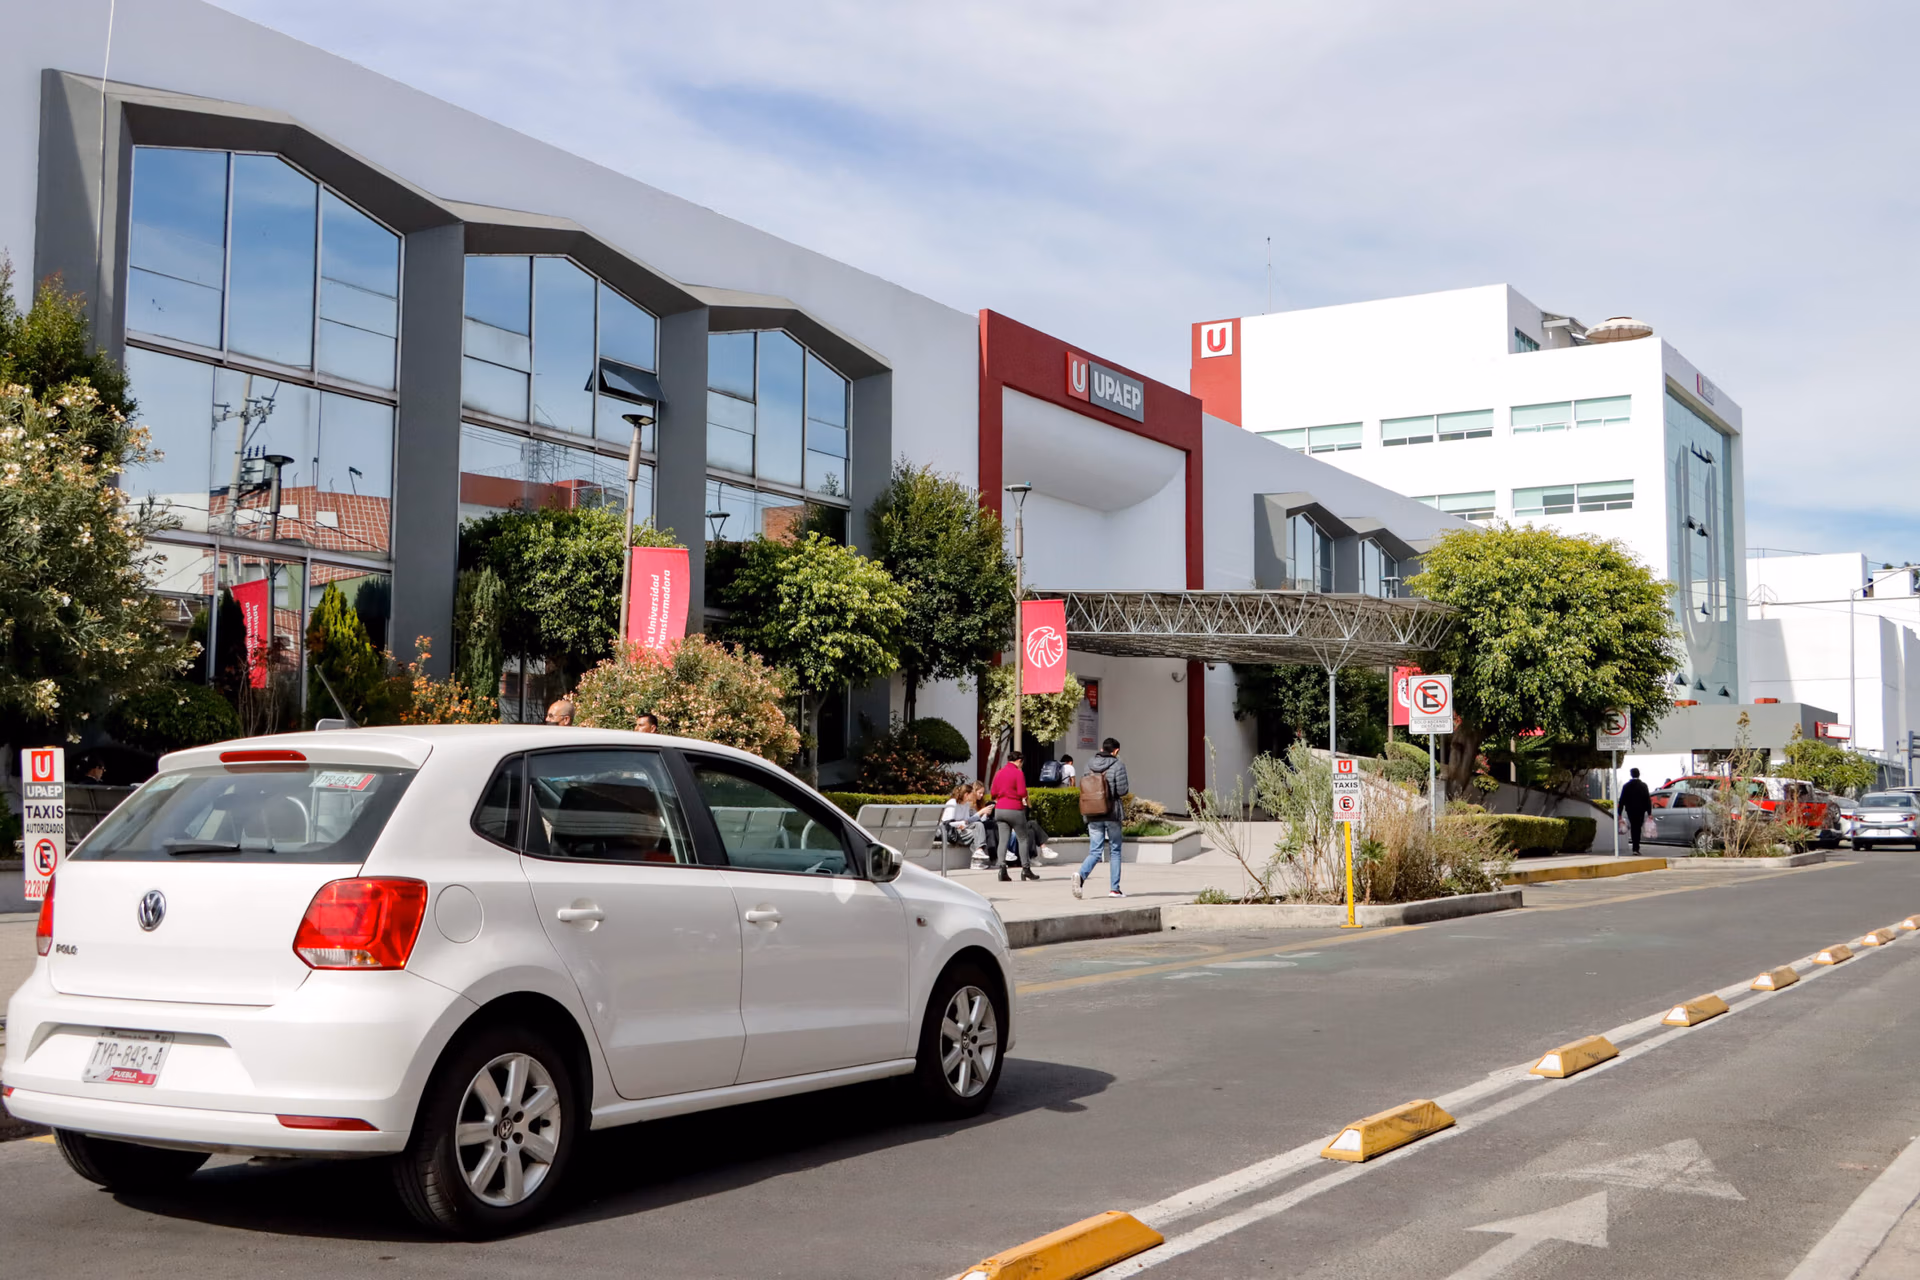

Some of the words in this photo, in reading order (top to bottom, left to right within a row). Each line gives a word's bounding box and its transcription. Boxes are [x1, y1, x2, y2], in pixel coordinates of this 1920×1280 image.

[1207, 327, 1226, 353] U
[1072, 360, 1086, 393] U
[1094, 370, 1141, 411] UPAEP
[648, 574, 660, 634] Universidad
[655, 569, 671, 650] Transformadora
[645, 637, 655, 648] La
[35, 755, 51, 778] U
[1340, 761, 1351, 772] U
[26, 785, 62, 798] UPAEP
[25, 805, 64, 819] TAXIS
[26, 823, 64, 834] AUTORIZADOS
[56, 943, 78, 955] POLO
[91, 1042, 164, 1071] TYR-843-A
[113, 1070, 137, 1079] PUEBLA
